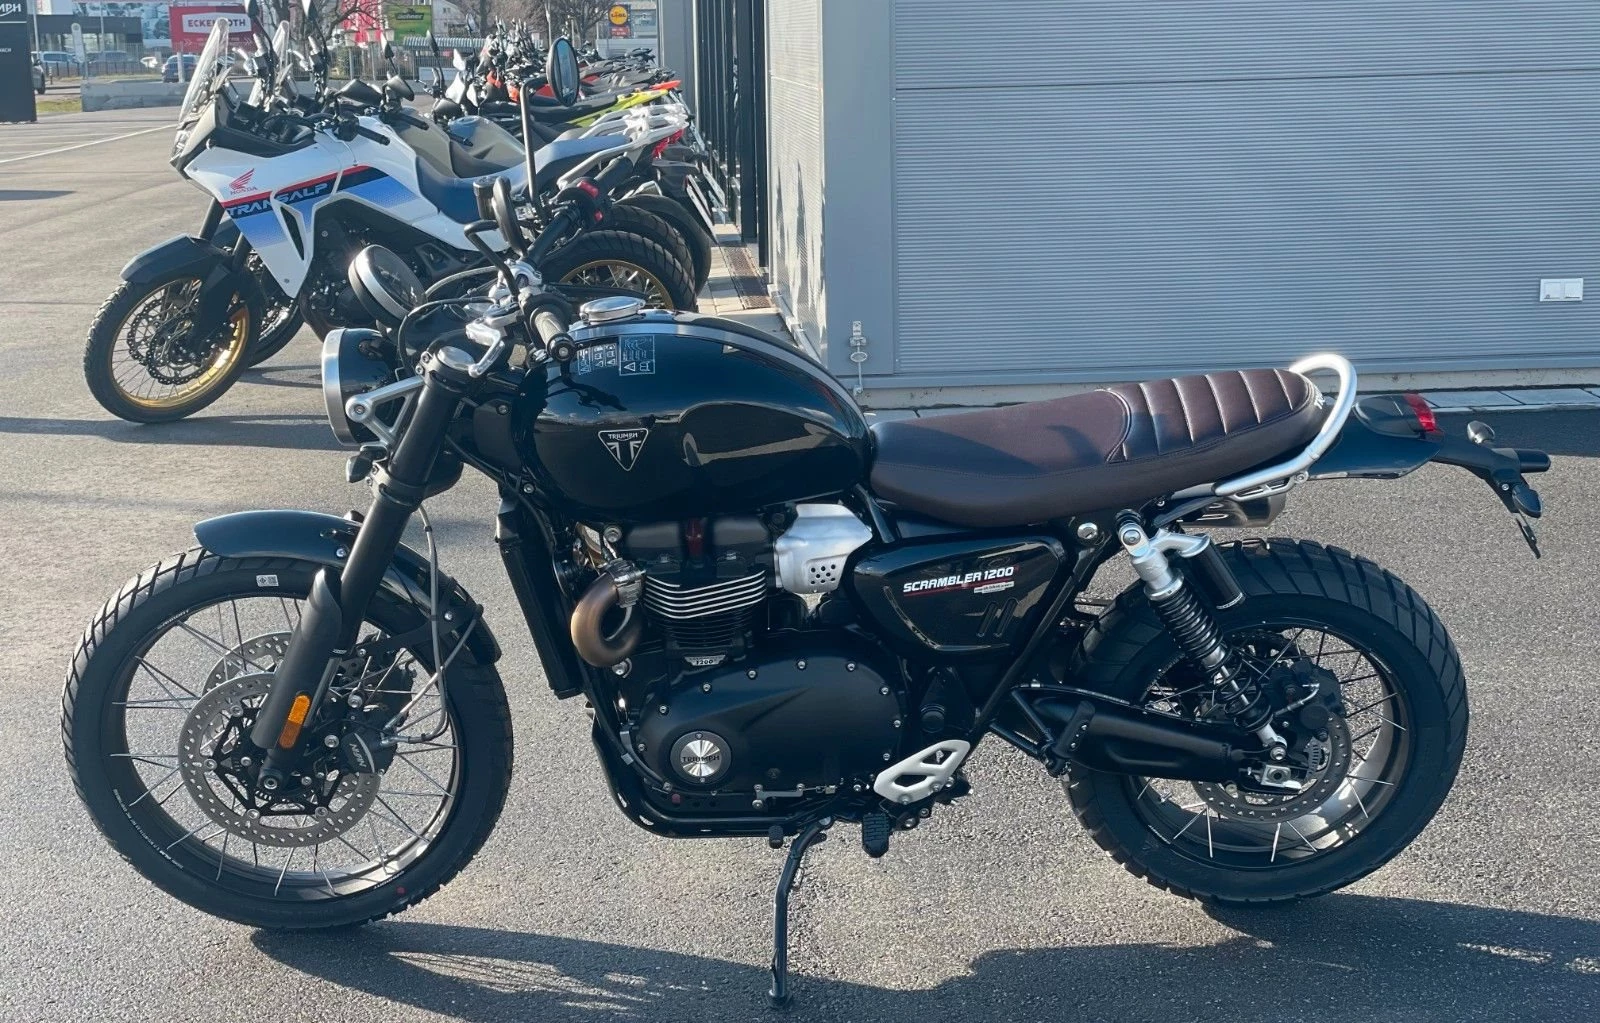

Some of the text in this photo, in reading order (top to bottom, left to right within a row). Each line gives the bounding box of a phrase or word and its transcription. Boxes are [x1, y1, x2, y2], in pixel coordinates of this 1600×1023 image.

[230, 186, 258, 195] HONDA
[608, 432, 638, 440] TRIUMPH
[903, 573, 981, 593] SCRAMBLER
[984, 566, 1014, 580] 1200
[682, 755, 720, 763] TRIUMPH
